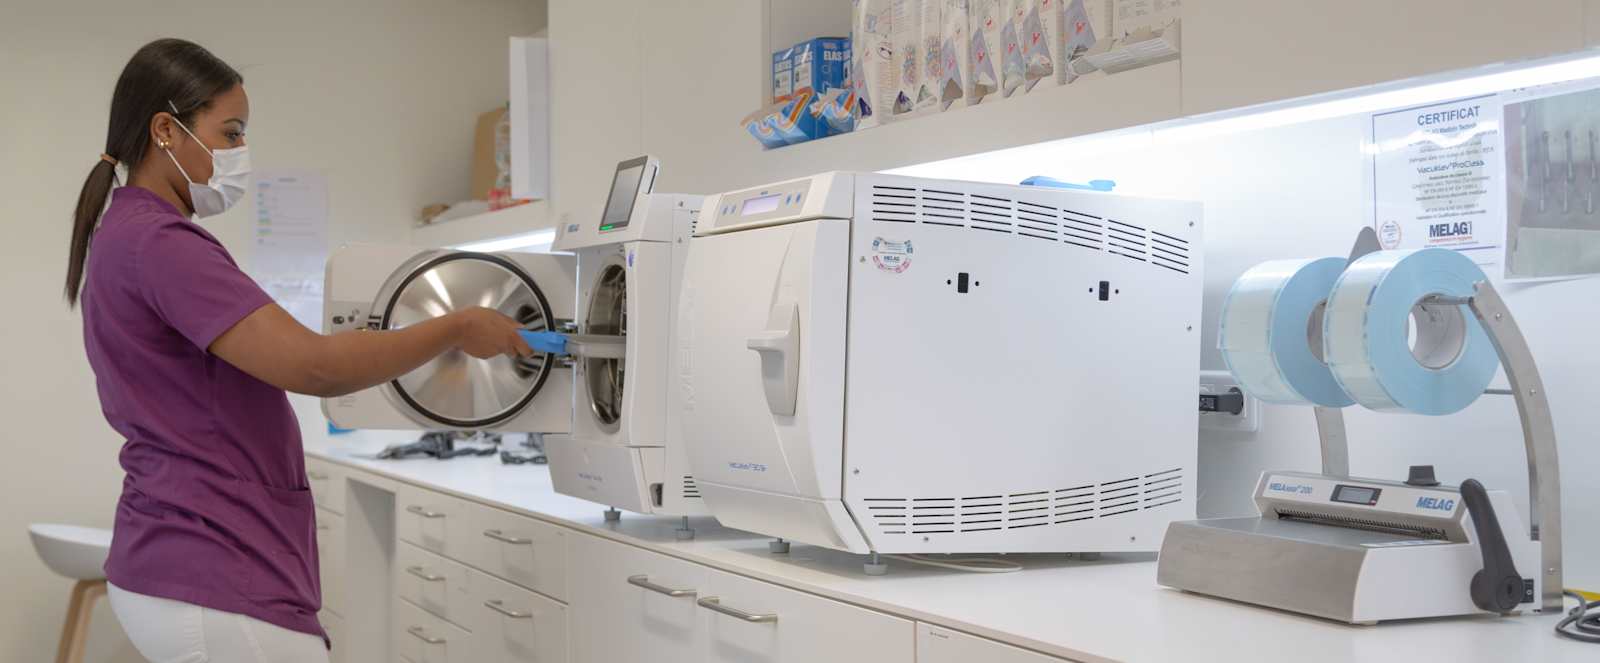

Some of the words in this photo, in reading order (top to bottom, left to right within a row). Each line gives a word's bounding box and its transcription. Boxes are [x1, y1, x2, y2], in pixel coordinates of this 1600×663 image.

[1417, 105, 1480, 125] CERTIFICAT
[1429, 221, 1468, 237] MELAG
[1416, 496, 1454, 512] MELAG
